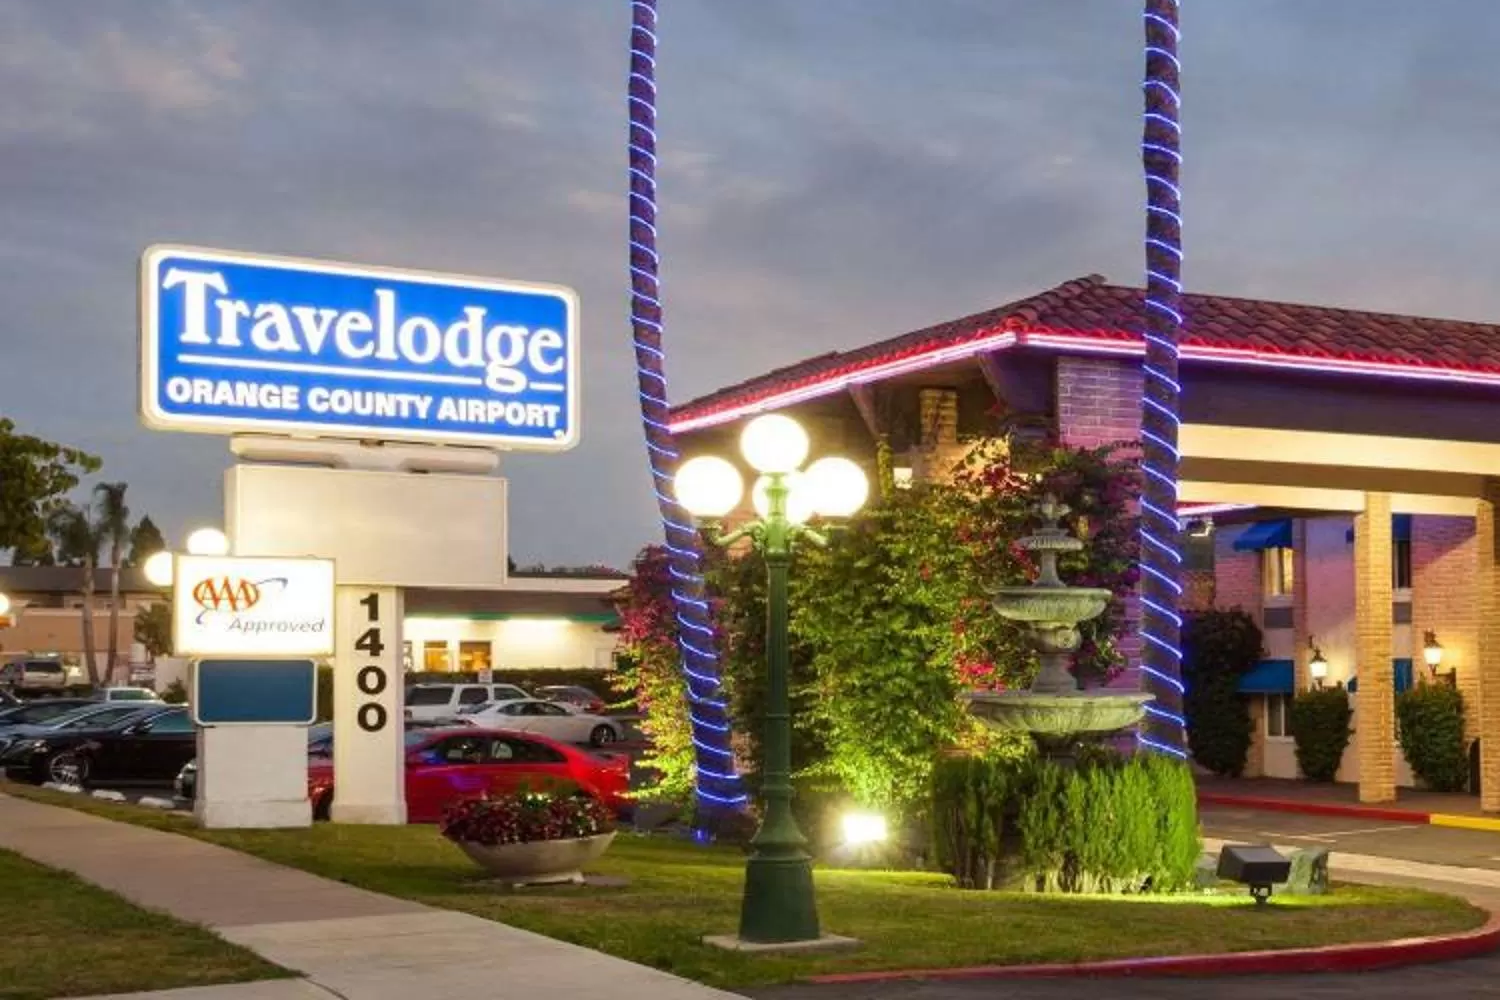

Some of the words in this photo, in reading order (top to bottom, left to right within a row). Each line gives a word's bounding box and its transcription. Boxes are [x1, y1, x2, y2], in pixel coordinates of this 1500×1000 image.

[162, 268, 564, 393] Travelodge
[166, 377, 299, 410] ORANGE
[308, 387, 431, 419] COUNTY
[438, 397, 560, 428] AIRPORT
[196, 576, 257, 611] AAA
[228, 617, 325, 634] Approved
[355, 593, 387, 732] 1400
